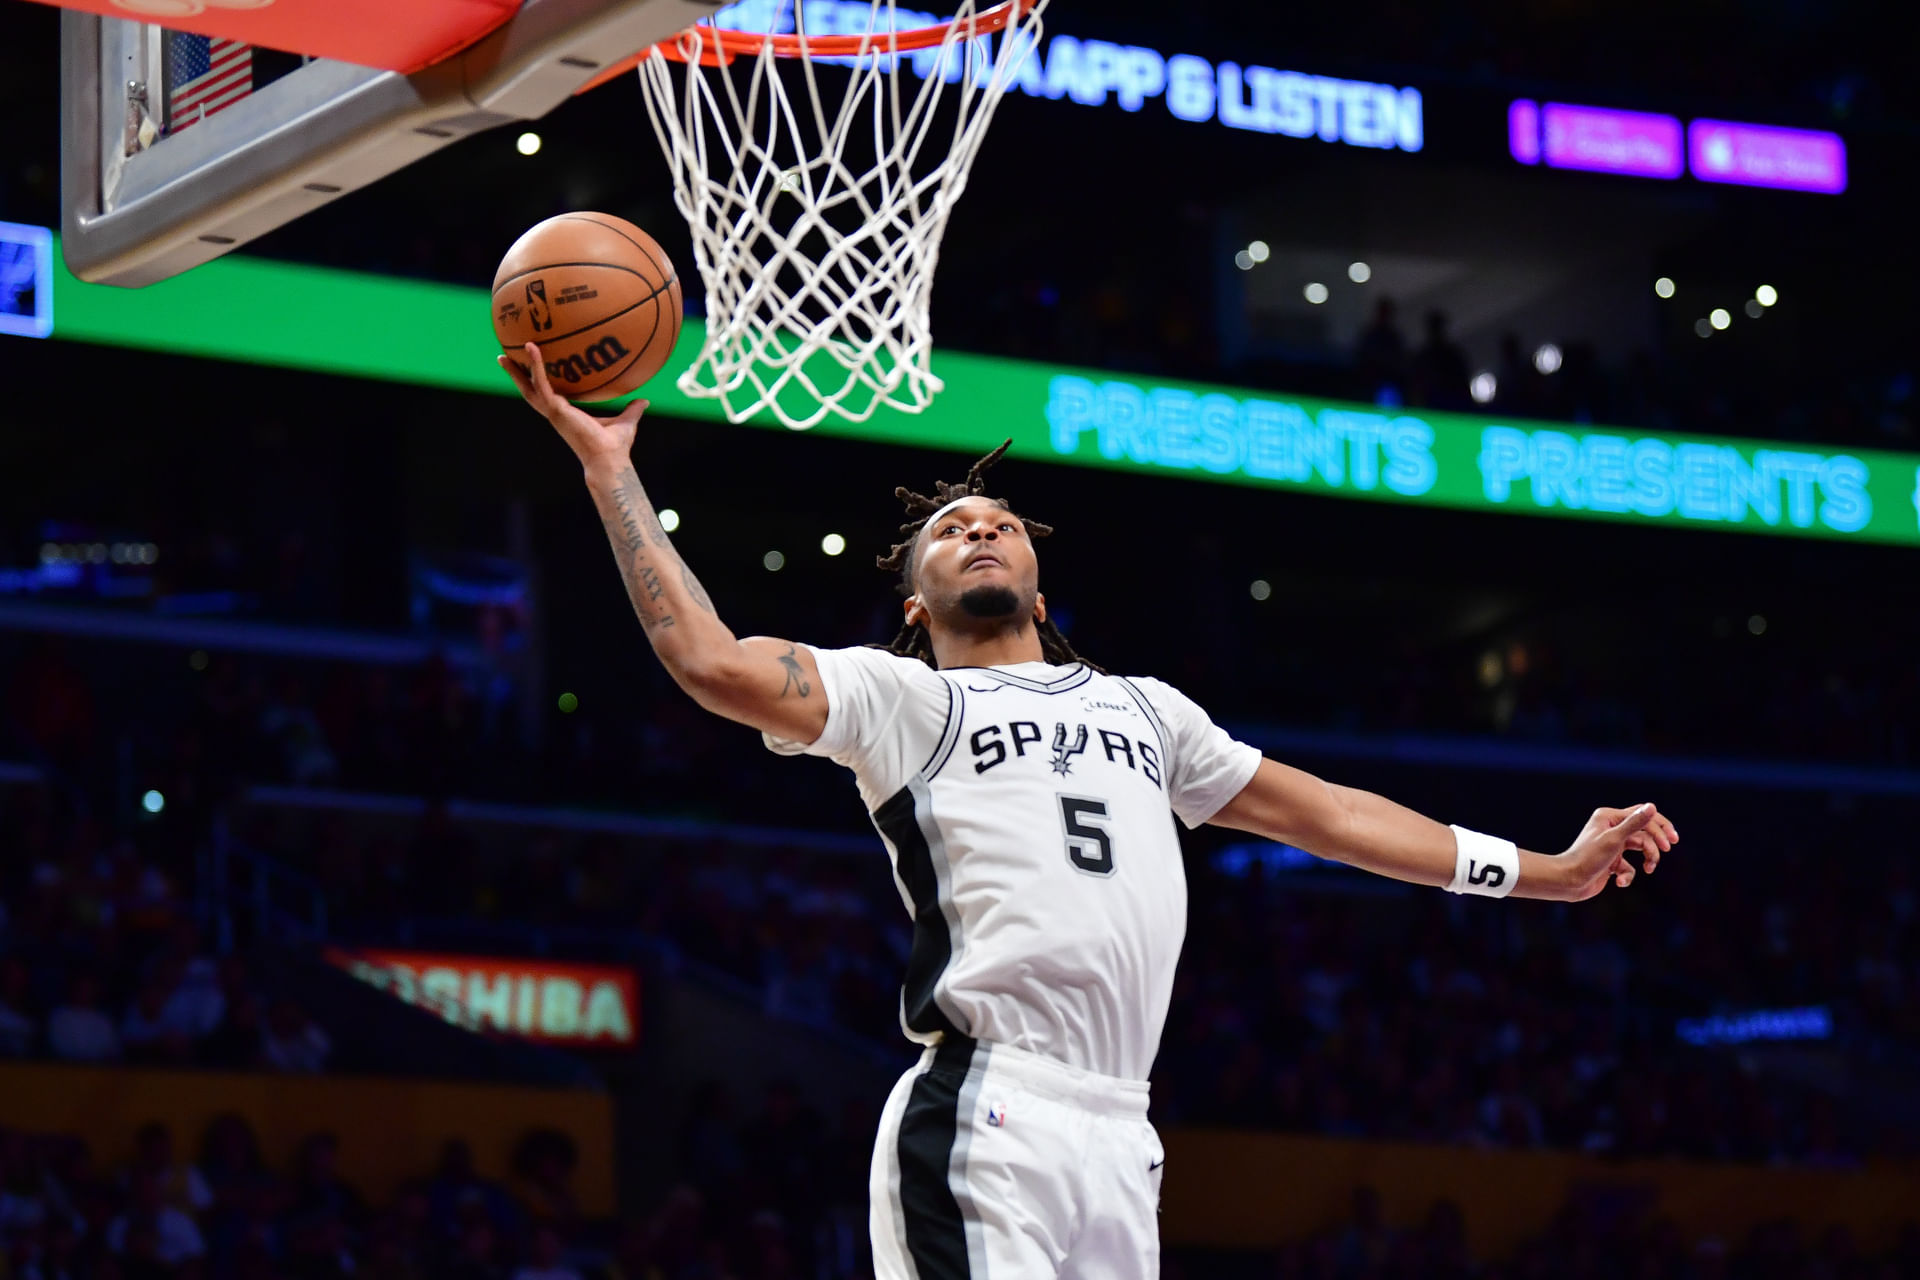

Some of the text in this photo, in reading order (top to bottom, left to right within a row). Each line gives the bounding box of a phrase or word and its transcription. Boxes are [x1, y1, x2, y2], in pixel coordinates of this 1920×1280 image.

[1045, 34, 1166, 112] APP
[1166, 53, 1215, 122] &
[1216, 60, 1423, 152] LISTEN
[520, 335, 630, 384] Wils
[1046, 374, 1437, 497] PRESENTS
[1477, 425, 1872, 533] PRESENTS
[970, 720, 1162, 792] SPURS
[1056, 791, 1118, 879] 5
[1468, 858, 1506, 888] 5
